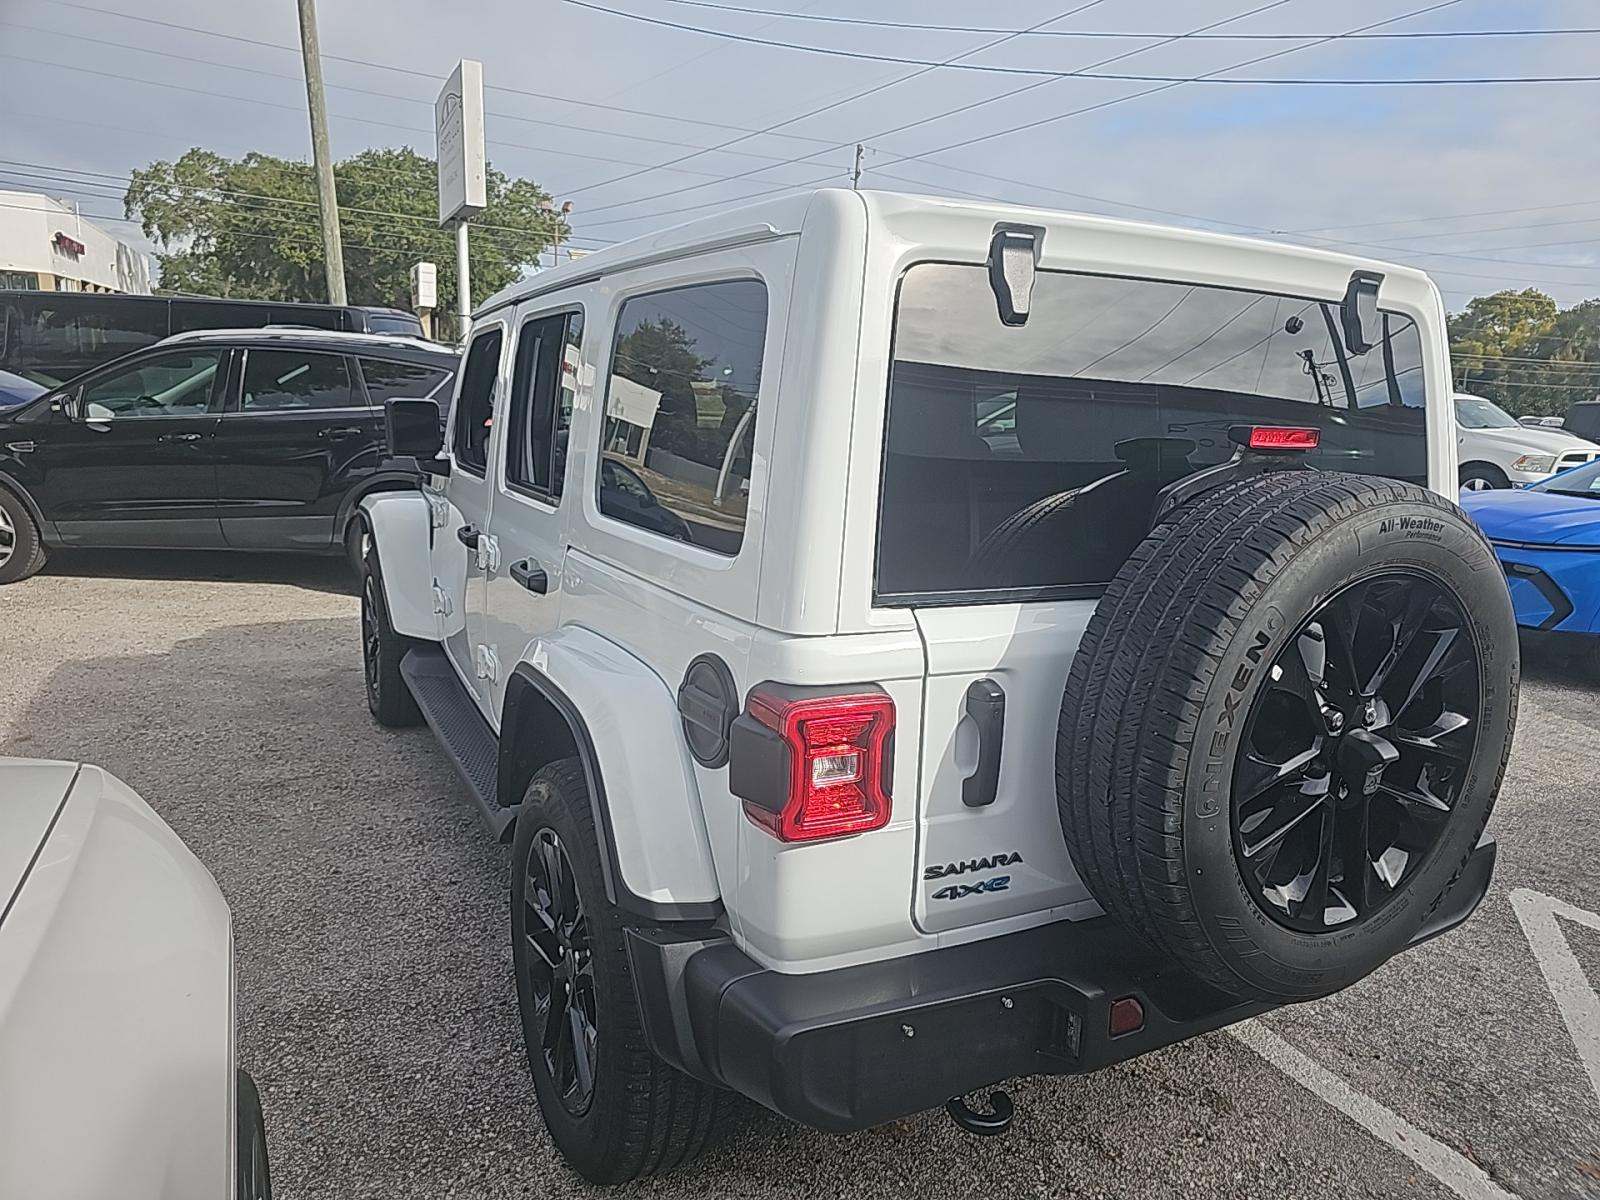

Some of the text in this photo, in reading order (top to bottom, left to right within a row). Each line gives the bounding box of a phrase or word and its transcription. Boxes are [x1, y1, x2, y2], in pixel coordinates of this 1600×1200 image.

[1379, 517, 1445, 535] All-Weather
[1203, 630, 1271, 793] NEXEN
[923, 851, 1023, 880] SAHARA
